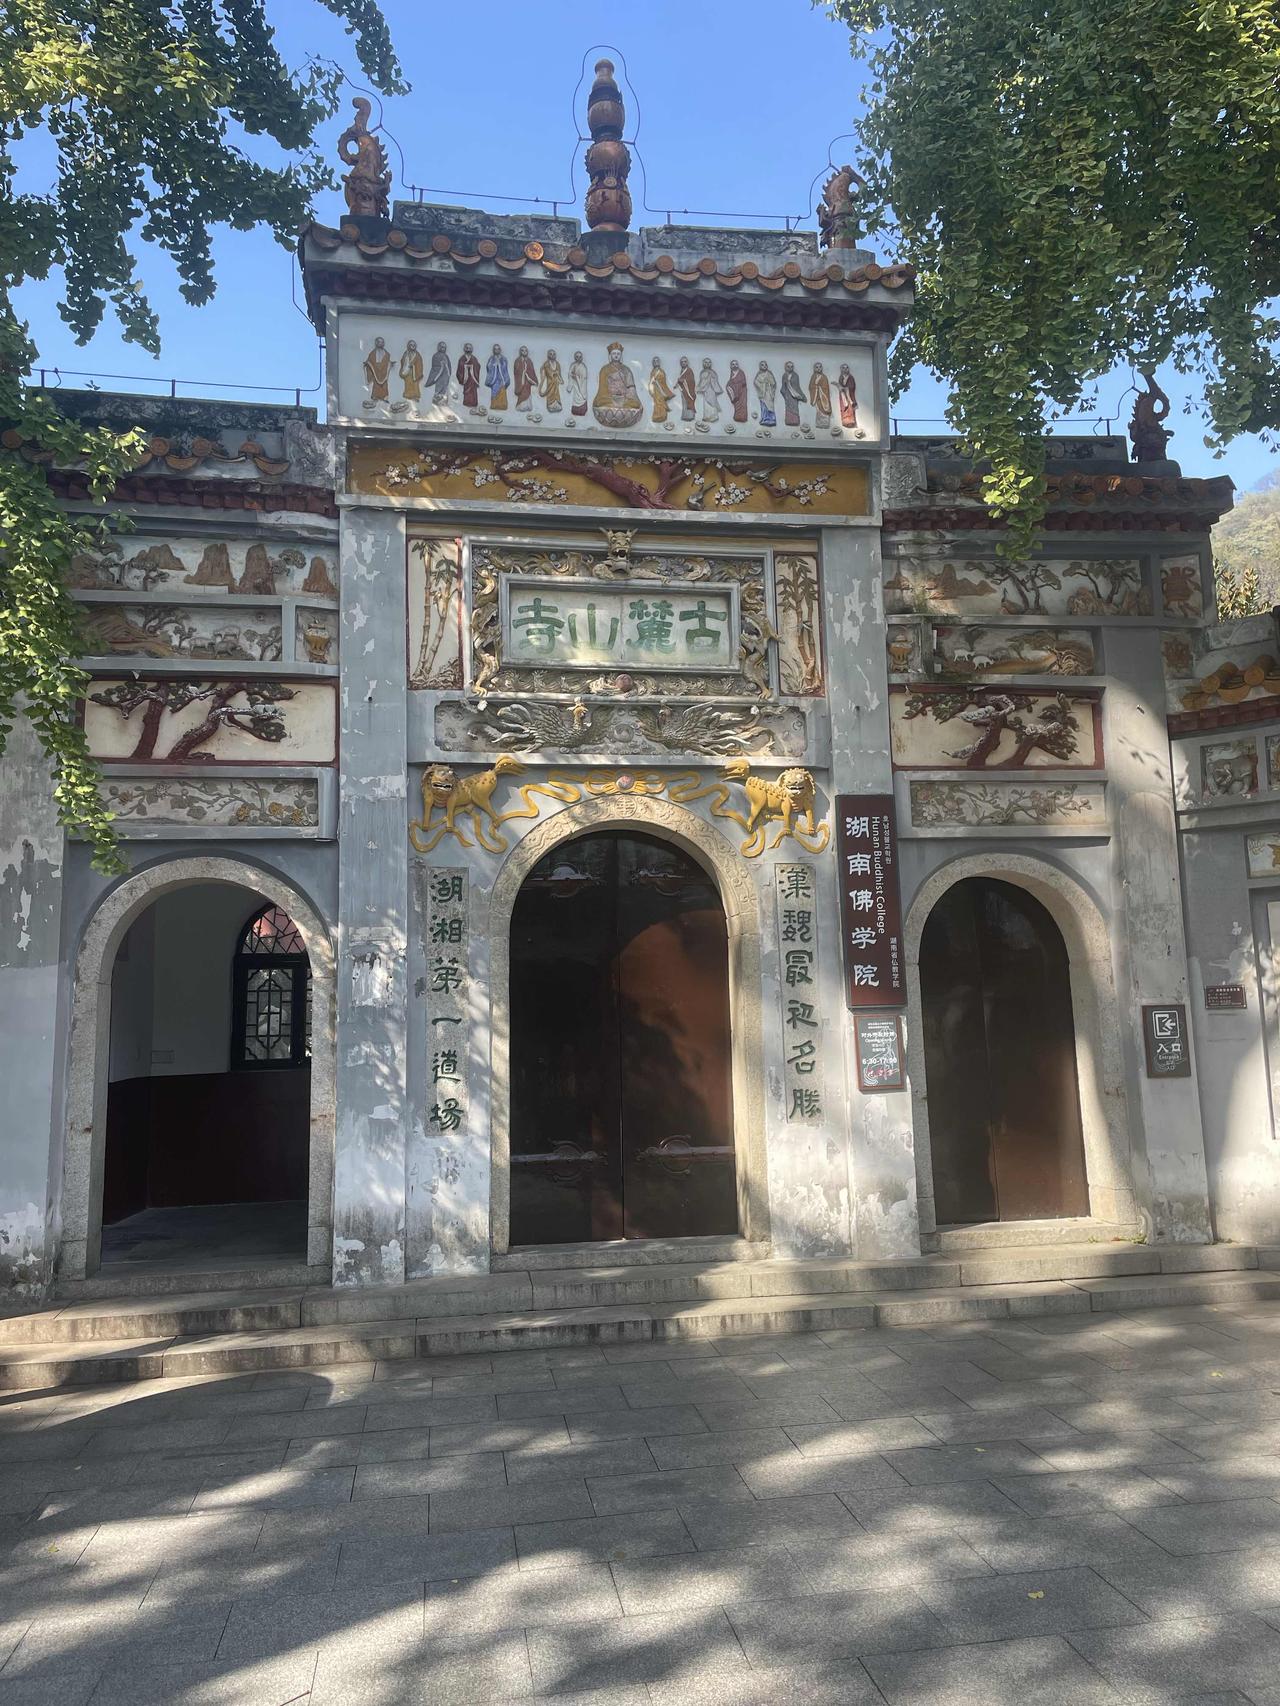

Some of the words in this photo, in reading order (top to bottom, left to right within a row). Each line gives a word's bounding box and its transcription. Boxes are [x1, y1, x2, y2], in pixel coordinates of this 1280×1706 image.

[872, 816, 880, 848] Hunan
[873, 850, 884, 894] Buddhist
[845, 816, 880, 987] 湖南佛学院
[876, 896, 886, 934] College
[1157, 1043, 1181, 1053] 入口
